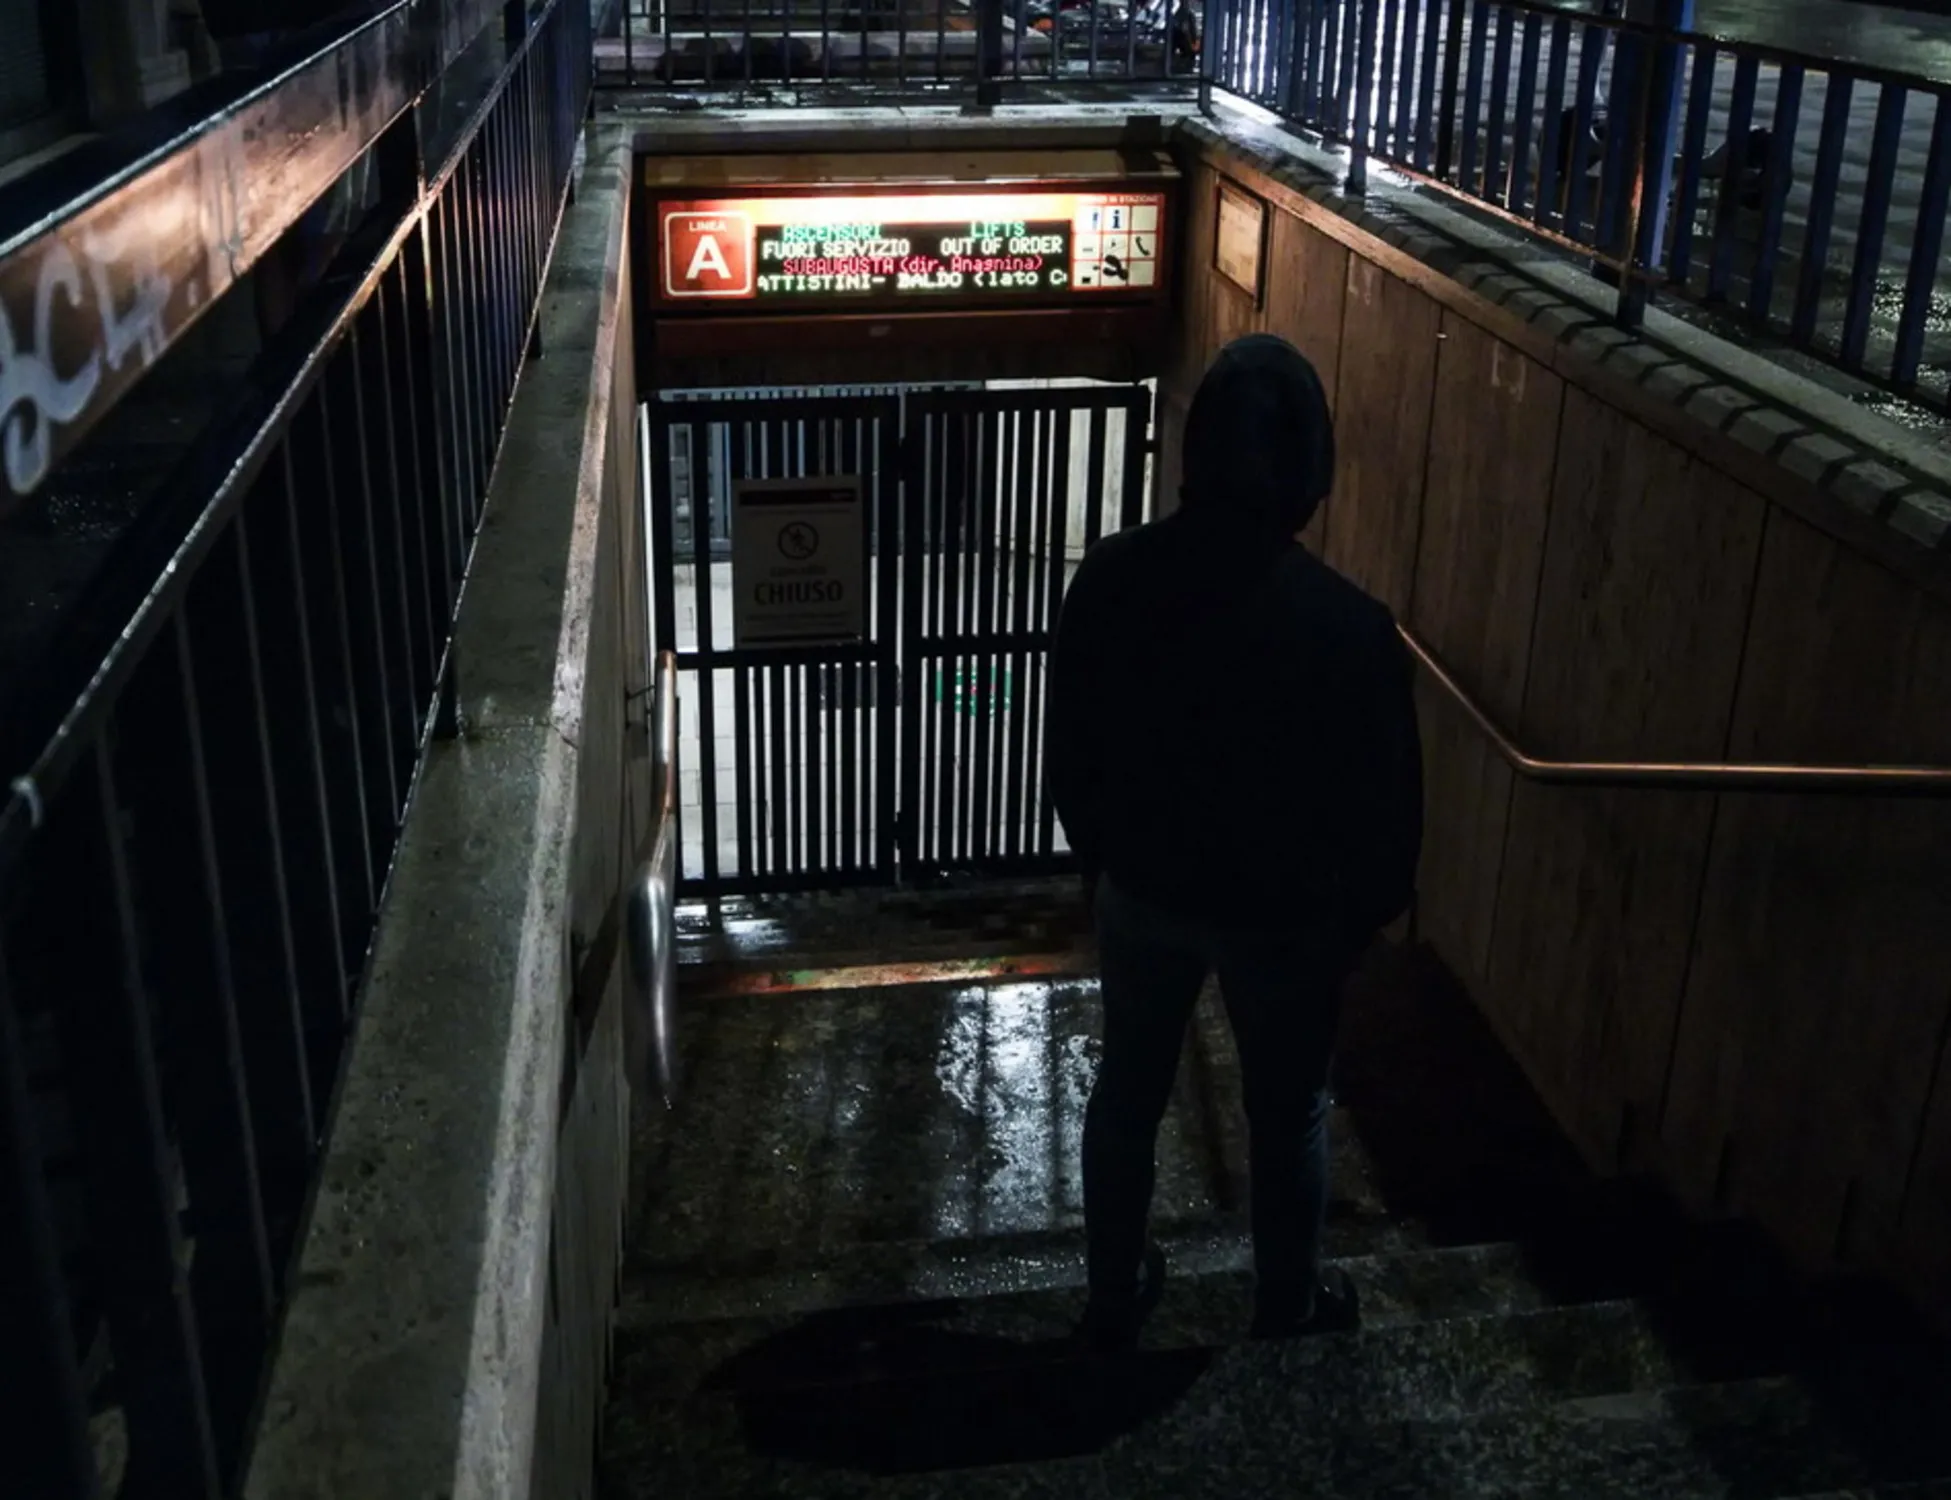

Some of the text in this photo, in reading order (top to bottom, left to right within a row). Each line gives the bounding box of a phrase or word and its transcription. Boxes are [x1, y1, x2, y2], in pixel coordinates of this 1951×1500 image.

[782, 224, 882, 242] ASCENSORI
[970, 221, 1025, 238] LIFTS
[762, 238, 910, 259] FUORI SERVIZIO
[940, 235, 1063, 256] OUT OF ORDER
[685, 234, 732, 280] A
[782, 257, 894, 275] SUBAUGUSTA
[754, 580, 844, 605] CHIUSO
